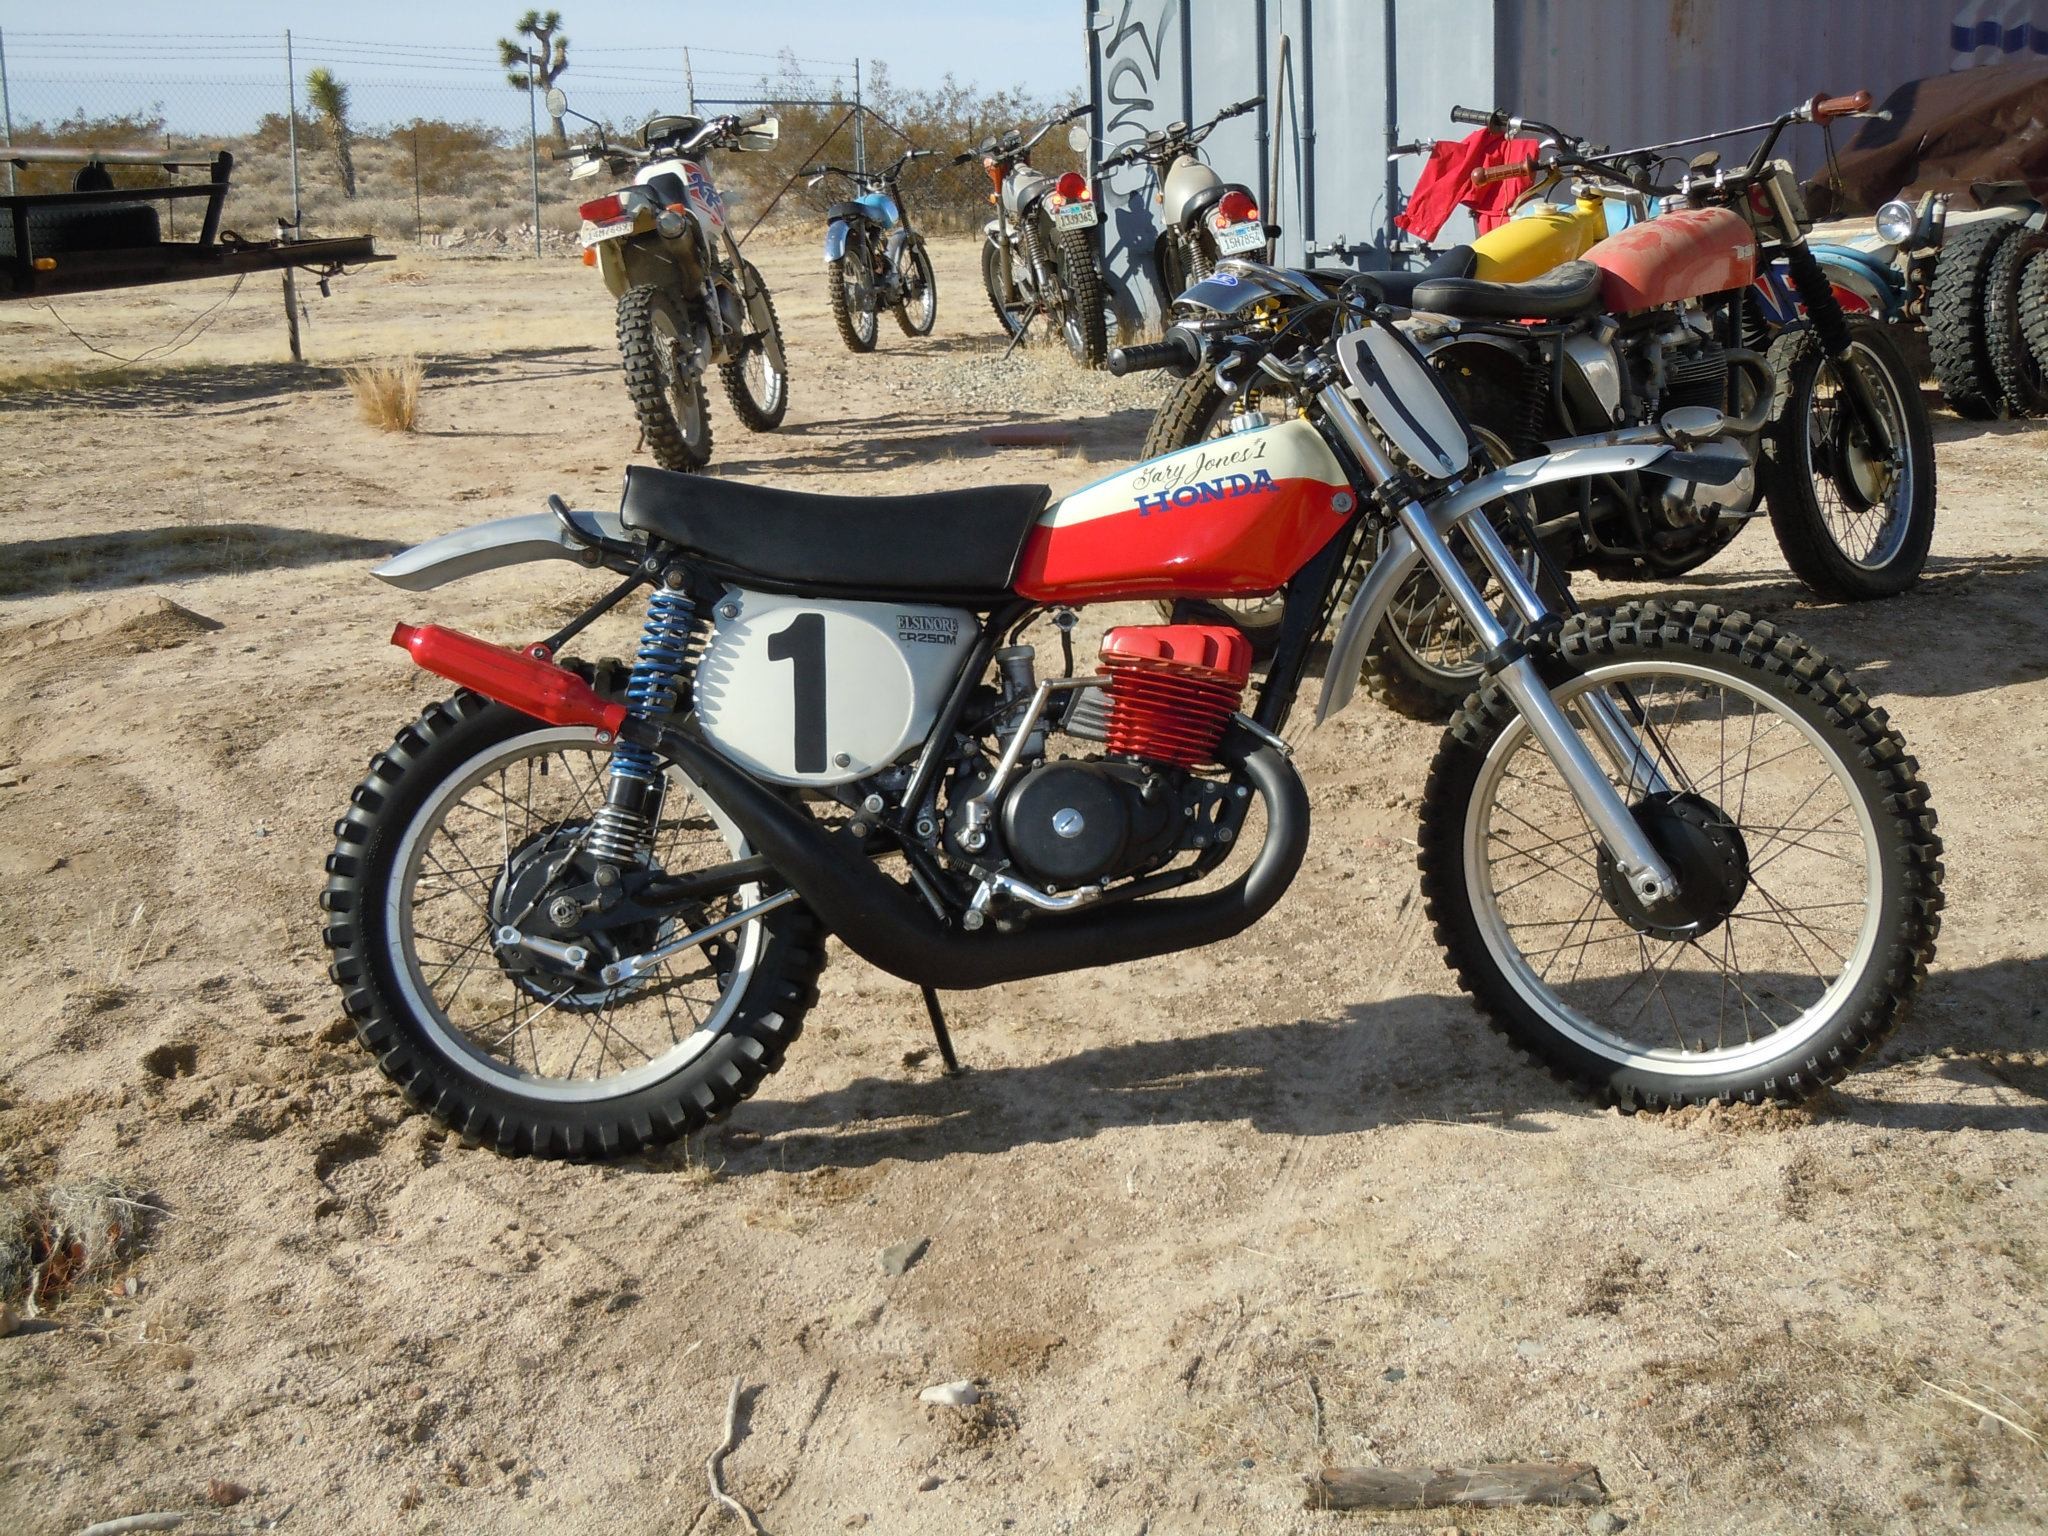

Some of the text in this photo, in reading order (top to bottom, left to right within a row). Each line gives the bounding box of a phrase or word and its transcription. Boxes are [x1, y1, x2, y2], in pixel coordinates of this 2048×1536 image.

[1355, 339, 1454, 473] 1
[1132, 464, 1187, 490] Gary
[1184, 447, 1252, 485] Jones
[1134, 468, 1281, 516] HONDA
[896, 614, 959, 635] ELSINORE
[899, 631, 957, 646] CR250M
[767, 613, 827, 773] 1
